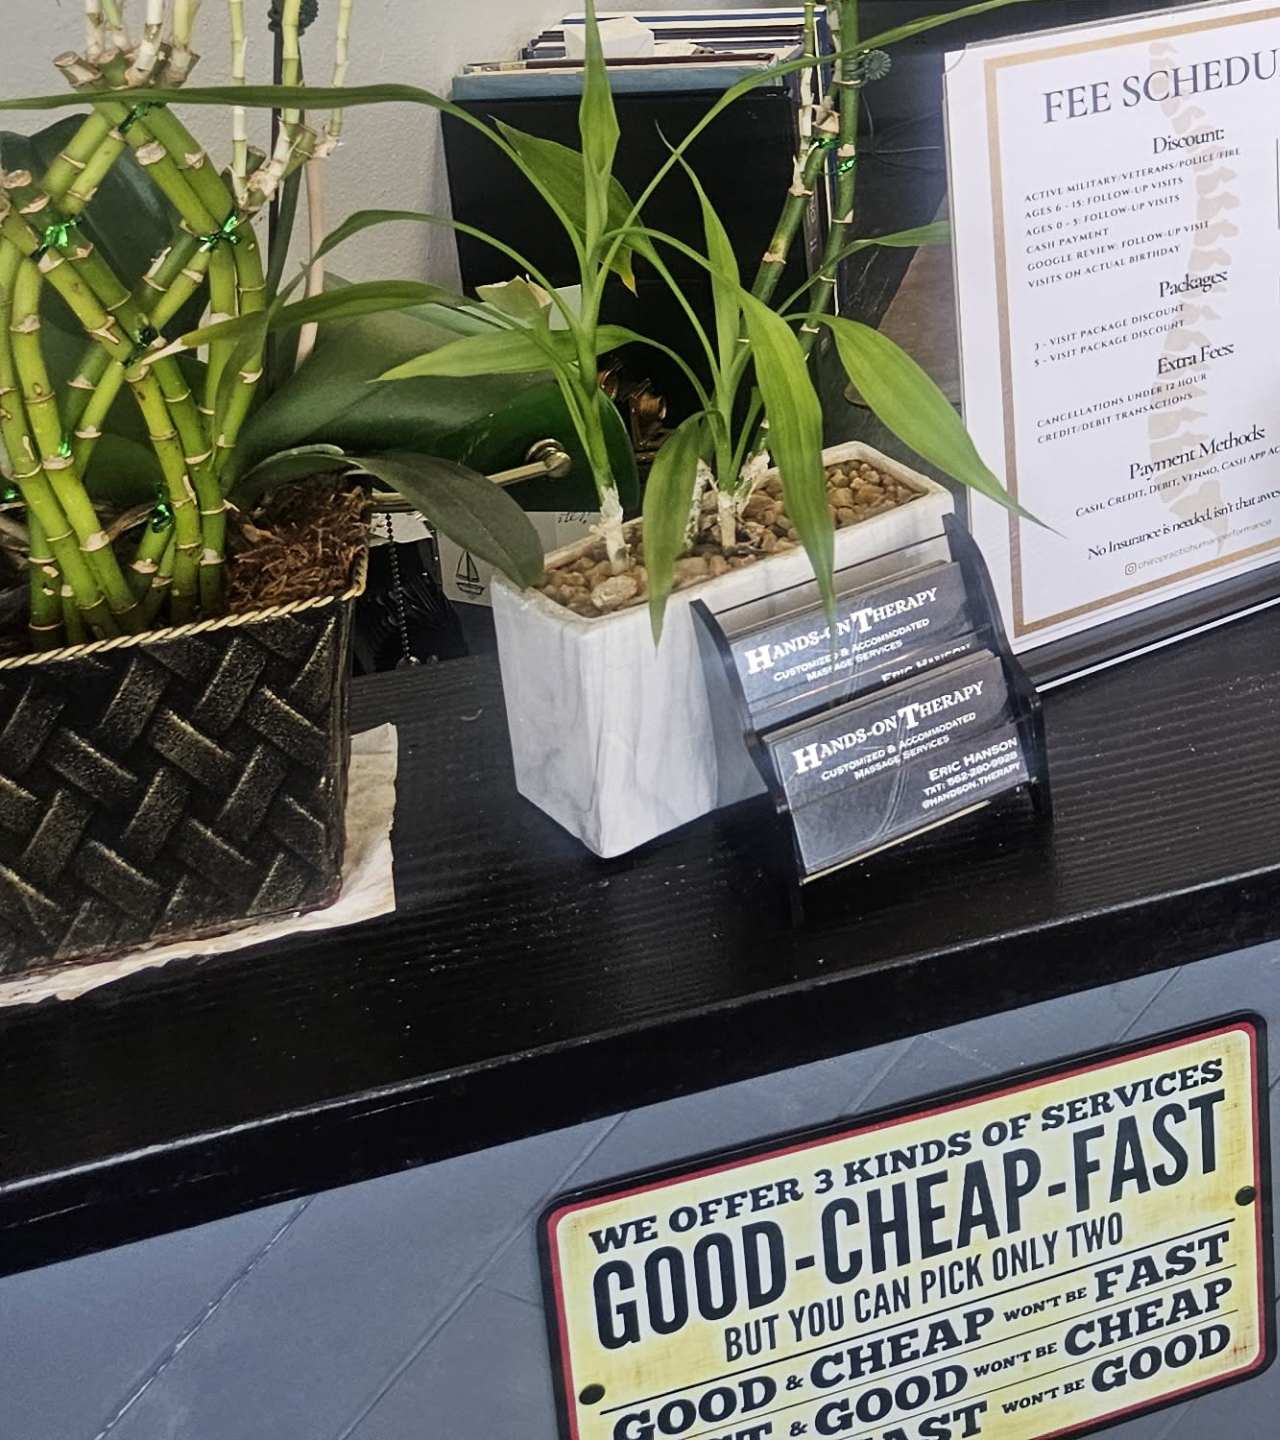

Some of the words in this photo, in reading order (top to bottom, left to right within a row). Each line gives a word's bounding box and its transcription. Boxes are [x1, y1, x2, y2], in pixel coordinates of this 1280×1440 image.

[1043, 82, 1111, 124] FEE
[1153, 128, 1225, 154] Discount:
[1026, 240, 1055, 254] CASH
[1058, 228, 1109, 246] PAYMENT
[1085, 258, 1125, 273] ACTUAL
[1129, 244, 1181, 264] BIRTHDAY
[1027, 255, 1072, 271] GOOGLE
[1049, 333, 1076, 346] VISIT
[1080, 319, 1129, 338] PACKAGE
[1131, 304, 1184, 324] DISCOUNT
[1049, 349, 1076, 362] VISIT
[1080, 335, 1129, 354] PACKAGE
[1131, 320, 1184, 341] DISCOUNT
[1157, 355, 1197, 375] Extra
[1037, 397, 1124, 428] CANCELLATIONS
[1127, 385, 1163, 402] UNDER
[1116, 393, 1193, 422] TRANSACTIONS
[1129, 450, 1194, 481] Payment
[1199, 424, 1266, 458] Methods:
[1088, 546, 1107, 559] No
[1109, 529, 1161, 552] Insurance
[1163, 527, 1171, 535] is
[850, 587, 938, 634] THERAPY
[852, 618, 930, 653] ACCOMMODATED
[856, 639, 903, 664] SERVICES
[792, 715, 897, 775] HANDS-ON
[896, 680, 984, 730] THERAPY
[821, 749, 885, 781] CUSTOMIZED
[899, 712, 976, 749] ACCOMMODATED
[854, 754, 901, 780] MASSAGE
[902, 735, 950, 760] SERVICES
[928, 760, 960, 781] ERIC
[963, 737, 1018, 767] HANSON
[589, 1215, 659, 1256] WE
[668, 1178, 803, 1232] OFFER
[814, 1170, 835, 1195] 3
[844, 1131, 973, 1187] KINDS
[981, 1113, 1031, 1148] OF
[1041, 1059, 1223, 1133] SERVICES
[593, 1089, 1226, 1350] GOOD-CHEAP-FAST
[724, 1316, 780, 1362] BUT
[787, 1296, 846, 1343] YOU
[853, 1276, 911, 1325] CAN
[920, 1255, 984, 1304] PICK
[991, 1229, 1060, 1282] ONLY
[1066, 1211, 1123, 1261] TWO
[612, 1376, 778, 1440] GOOD
[785, 1376, 804, 1392] &
[810, 1307, 994, 1389] CHEAP
[1002, 1296, 1062, 1323] WON'T
[1064, 1287, 1088, 1307] BE
[1094, 1230, 1230, 1302] FAST
[789, 1421, 807, 1437] &
[815, 1365, 968, 1437] GOOD
[973, 1353, 1035, 1380] WON'T
[1032, 1342, 1057, 1363] BE
[1063, 1277, 1233, 1357] CHEAP
[1001, 1389, 1061, 1415] WON'T
[1063, 1379, 1086, 1400] BE
[1091, 1324, 1231, 1392] GOOD
